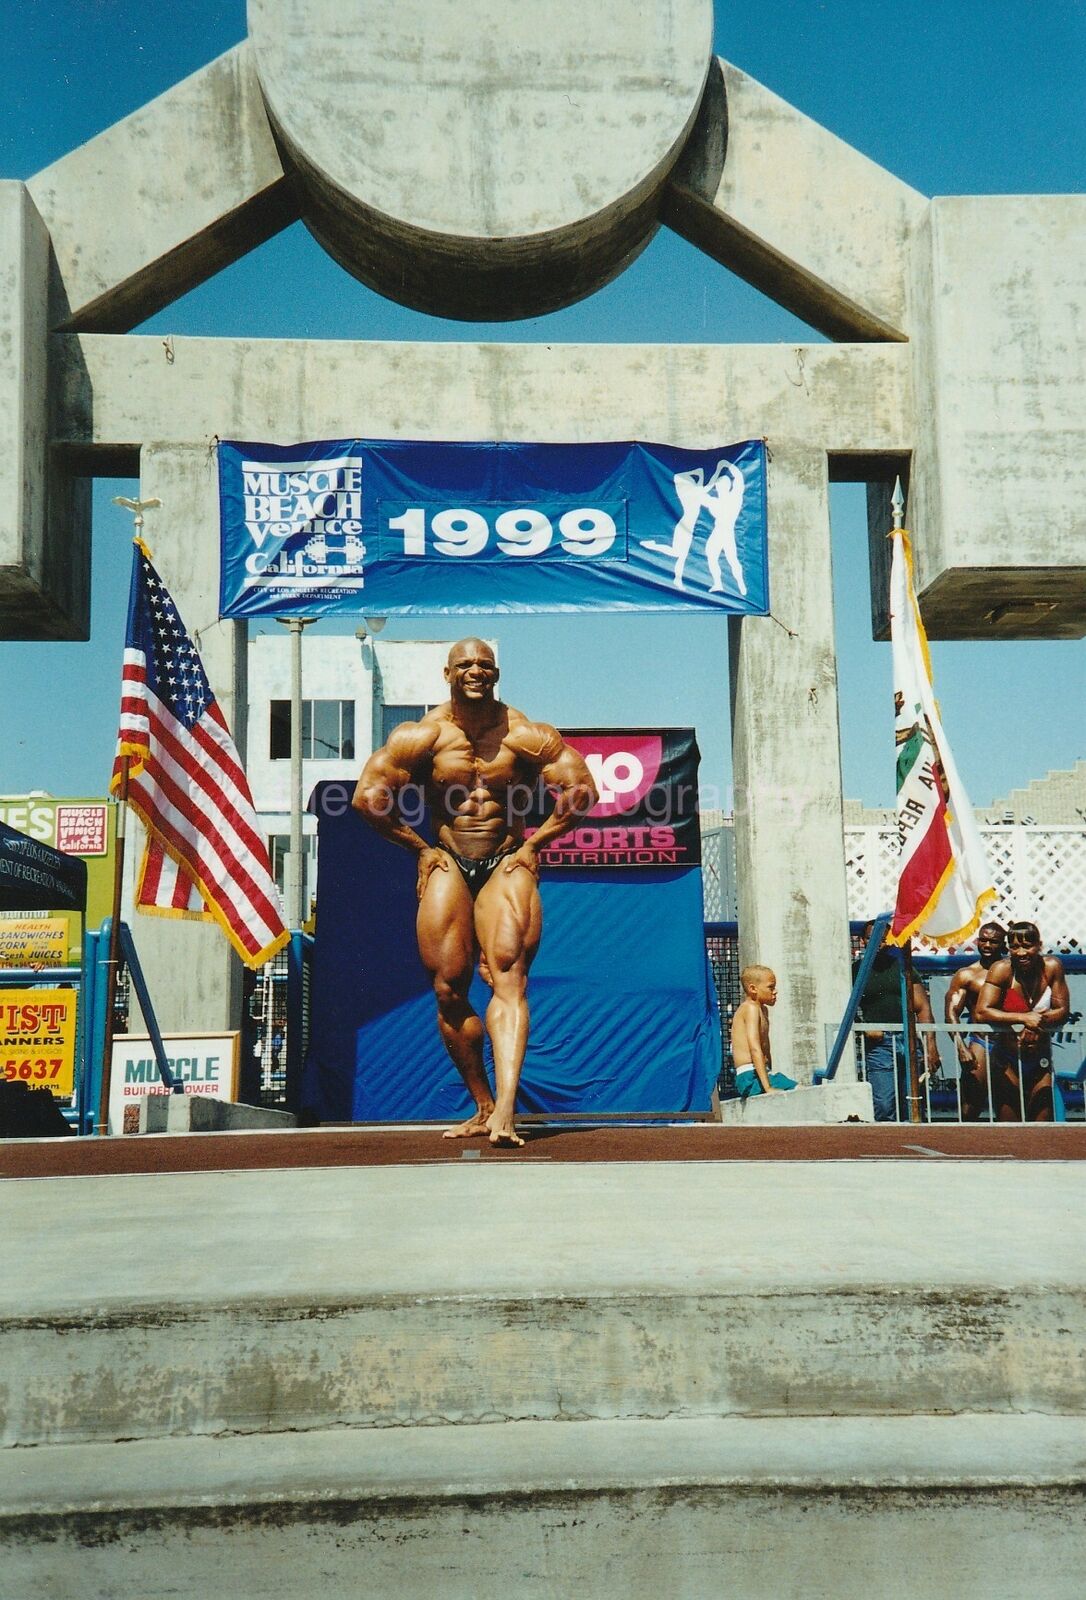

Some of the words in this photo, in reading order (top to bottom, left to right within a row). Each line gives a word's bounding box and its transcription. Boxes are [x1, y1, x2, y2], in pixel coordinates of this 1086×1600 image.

[243, 468, 362, 495] MUSCLE
[244, 491, 362, 522] BEACH
[244, 518, 362, 548] Venice
[389, 508, 616, 556] 1999
[245, 551, 363, 576] California
[60, 808, 103, 817] MUSCLE
[60, 817, 103, 827] BEACH
[60, 827, 102, 839] VENICE
[60, 839, 102, 851] California
[0, 931, 65, 939] SANDWICHES
[28, 950, 63, 959] JUICES
